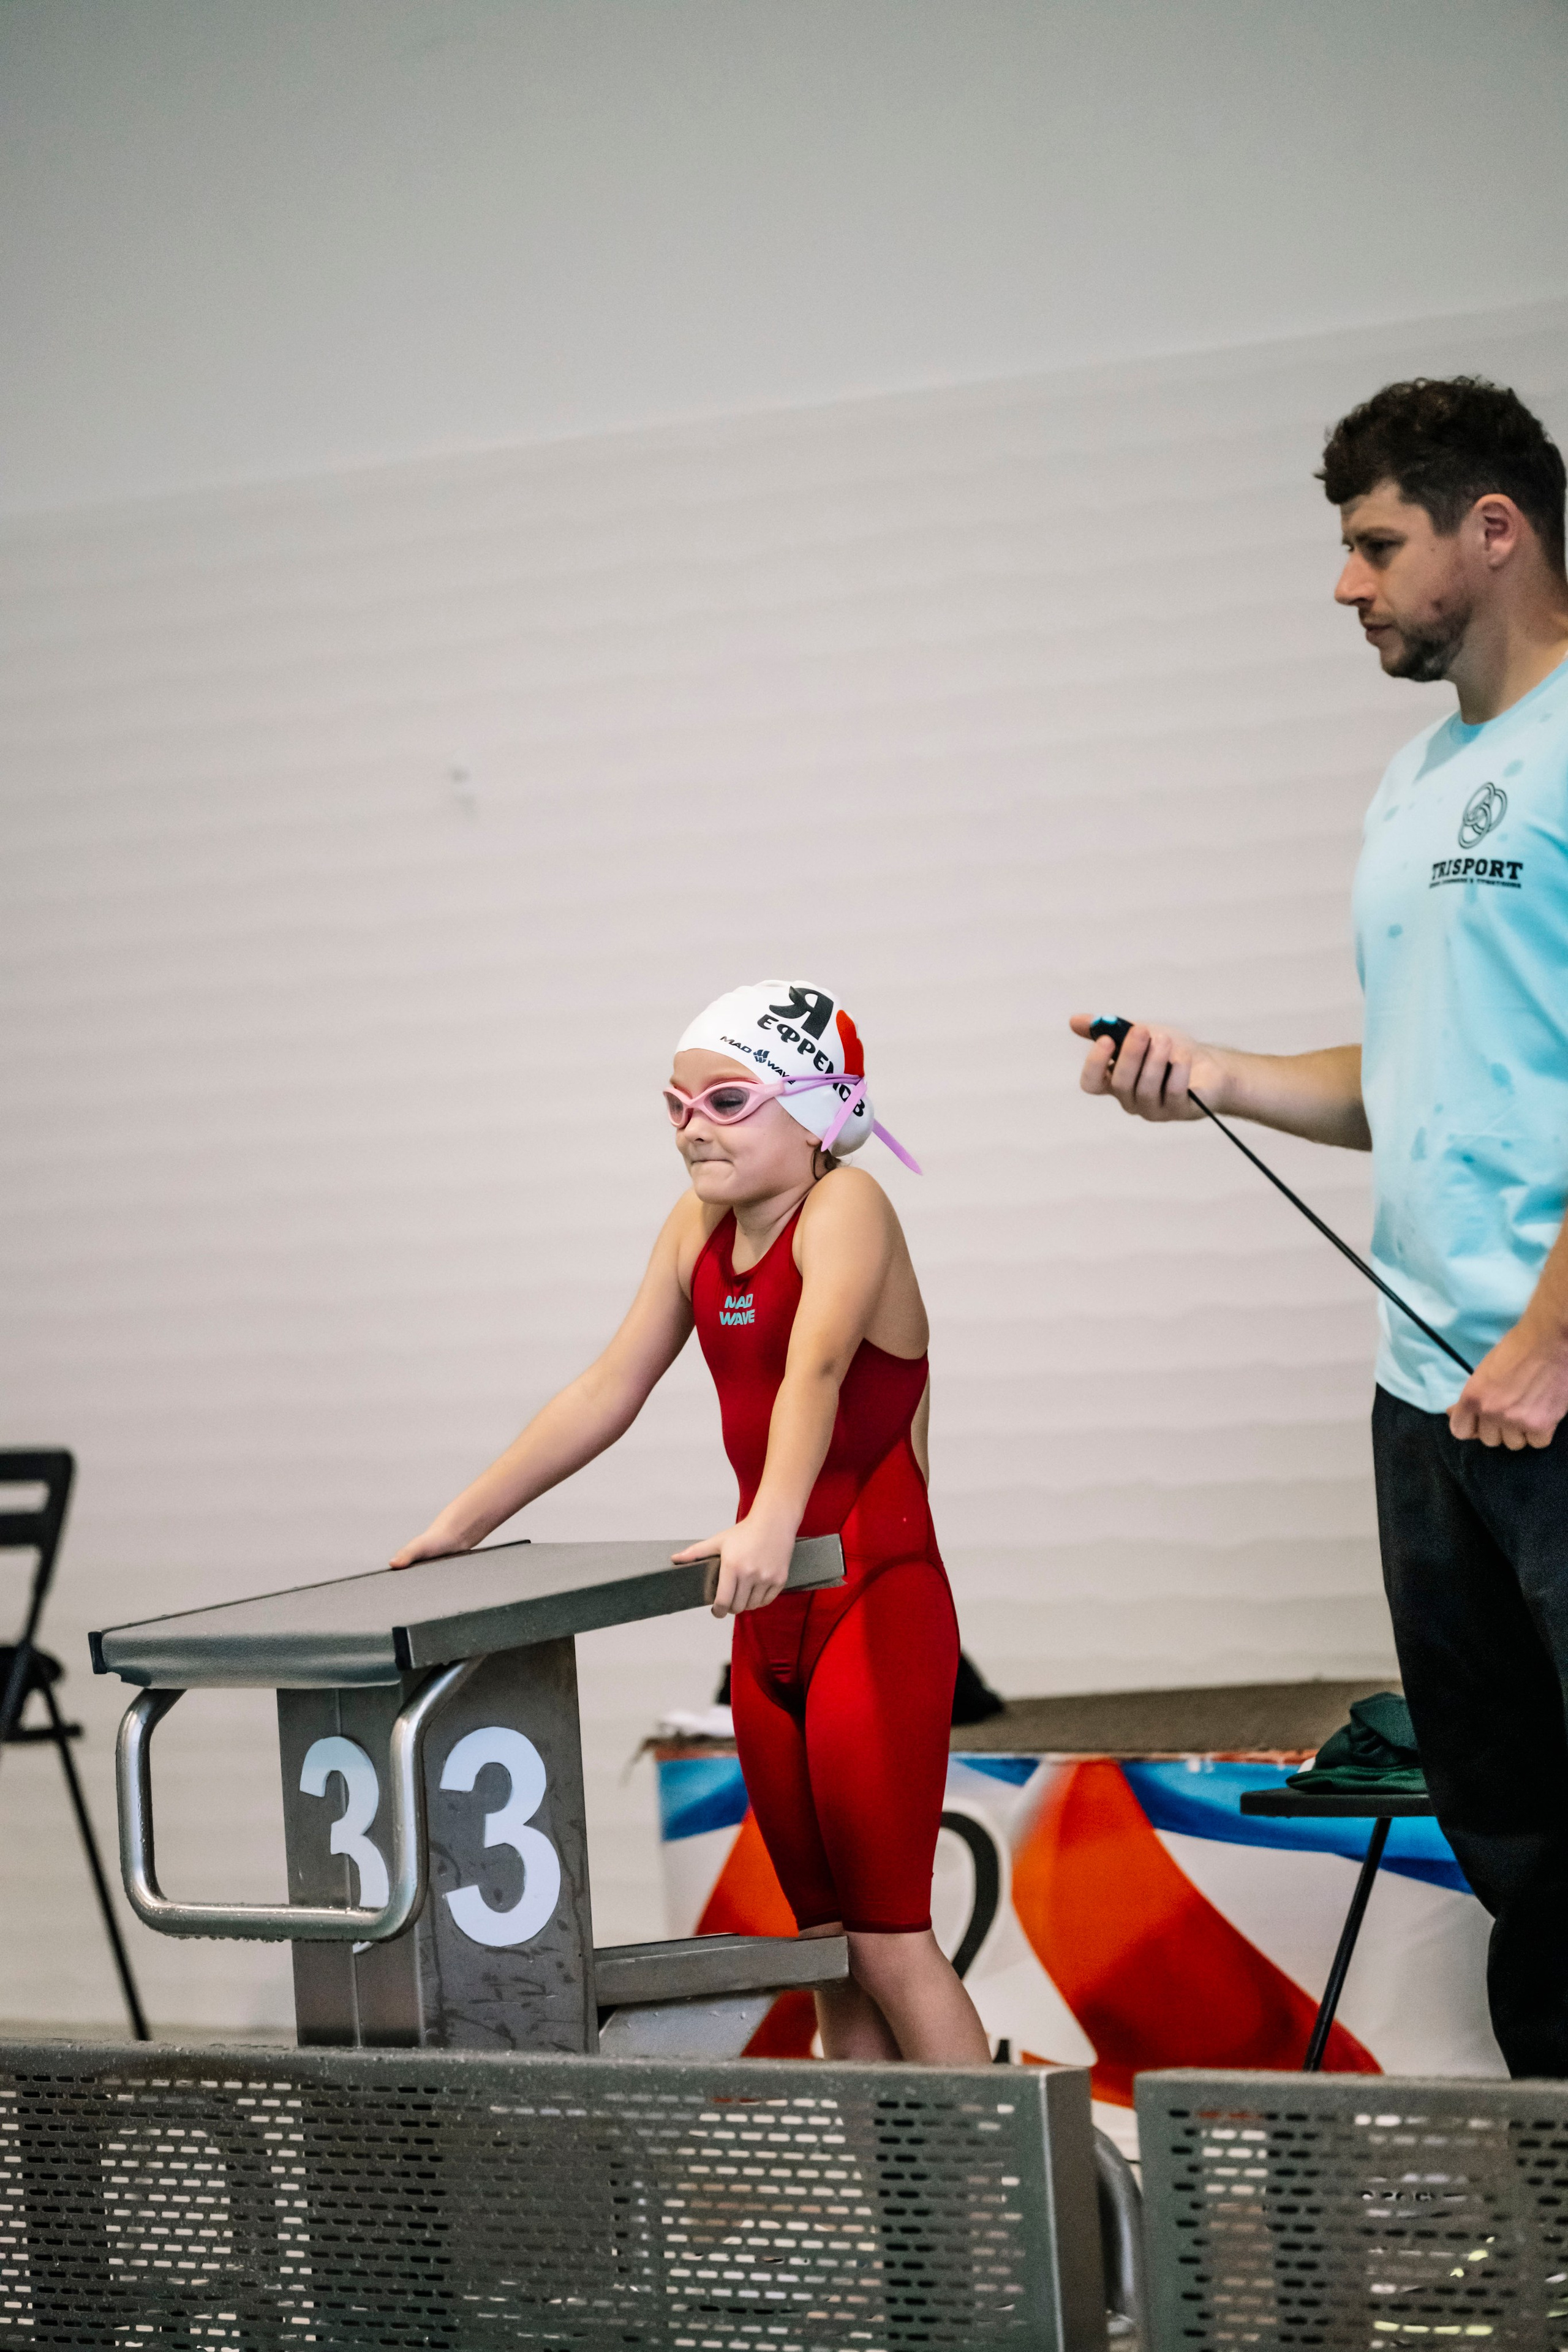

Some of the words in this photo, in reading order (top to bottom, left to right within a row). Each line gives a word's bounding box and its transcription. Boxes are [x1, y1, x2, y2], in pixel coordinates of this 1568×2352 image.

[1432, 858, 1523, 880] TRISPORT
[720, 1036, 752, 1054] MAD
[719, 1309, 755, 1325] WAVE
[300, 1736, 390, 1954] 3
[439, 1726, 561, 1948] 3
